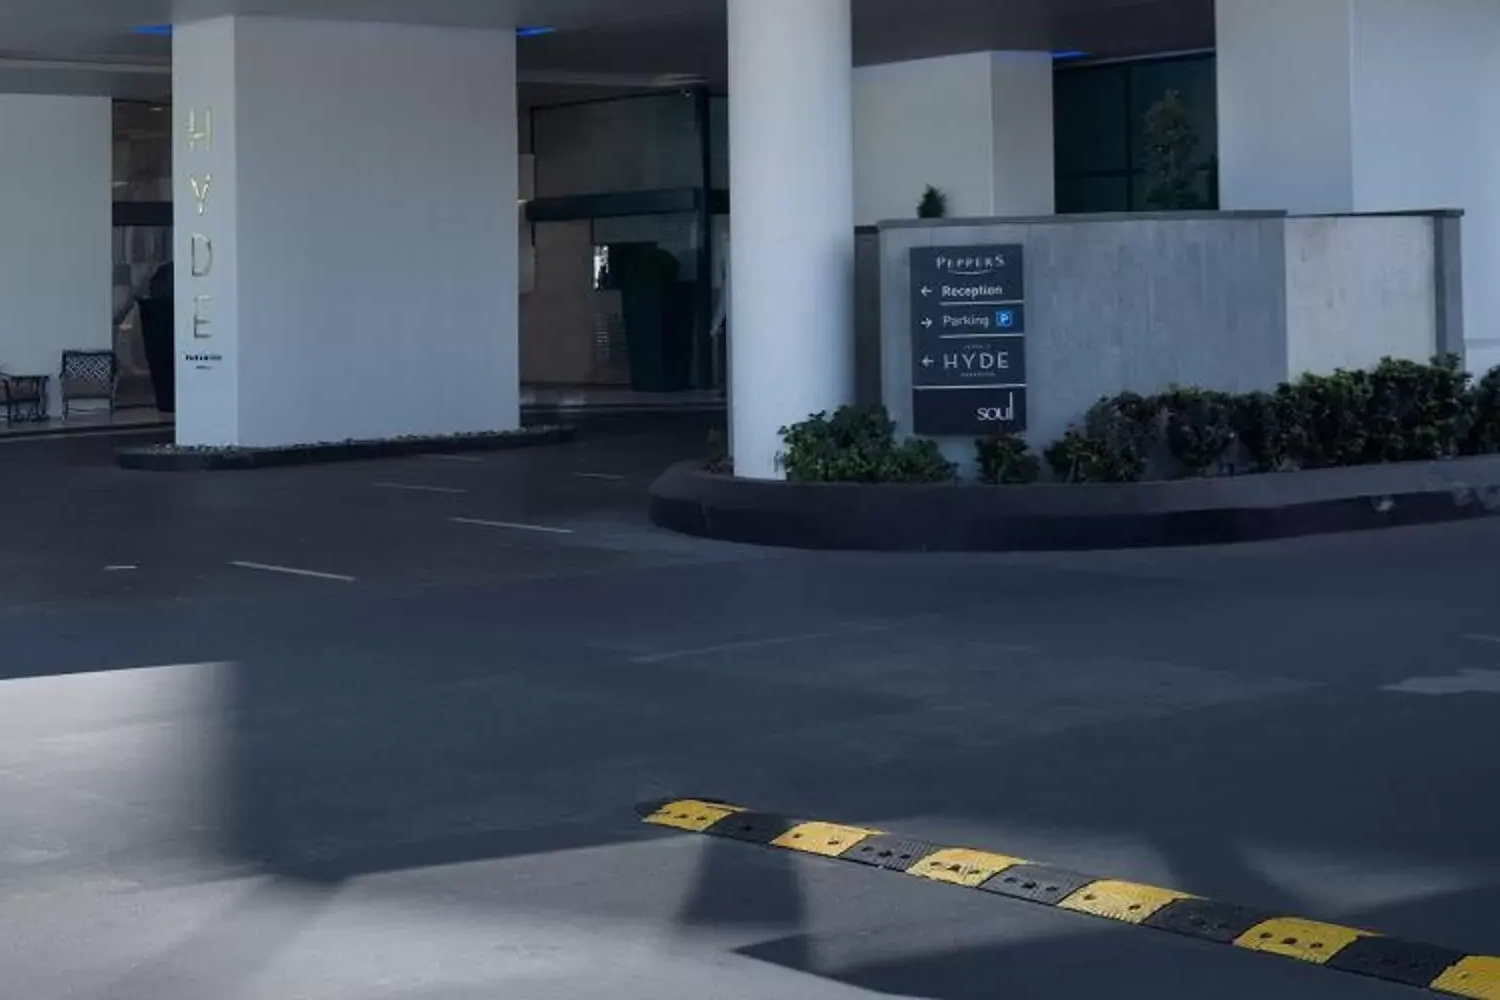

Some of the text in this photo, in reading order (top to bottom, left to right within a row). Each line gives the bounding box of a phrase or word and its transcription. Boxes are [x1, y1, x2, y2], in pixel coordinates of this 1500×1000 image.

[189, 106, 212, 339] HYDE
[936, 254, 1005, 269] PEPPERS
[941, 285, 1003, 300] Reception
[943, 315, 989, 328] Parking
[943, 351, 1009, 369] HYDE
[977, 391, 1014, 421] soul
